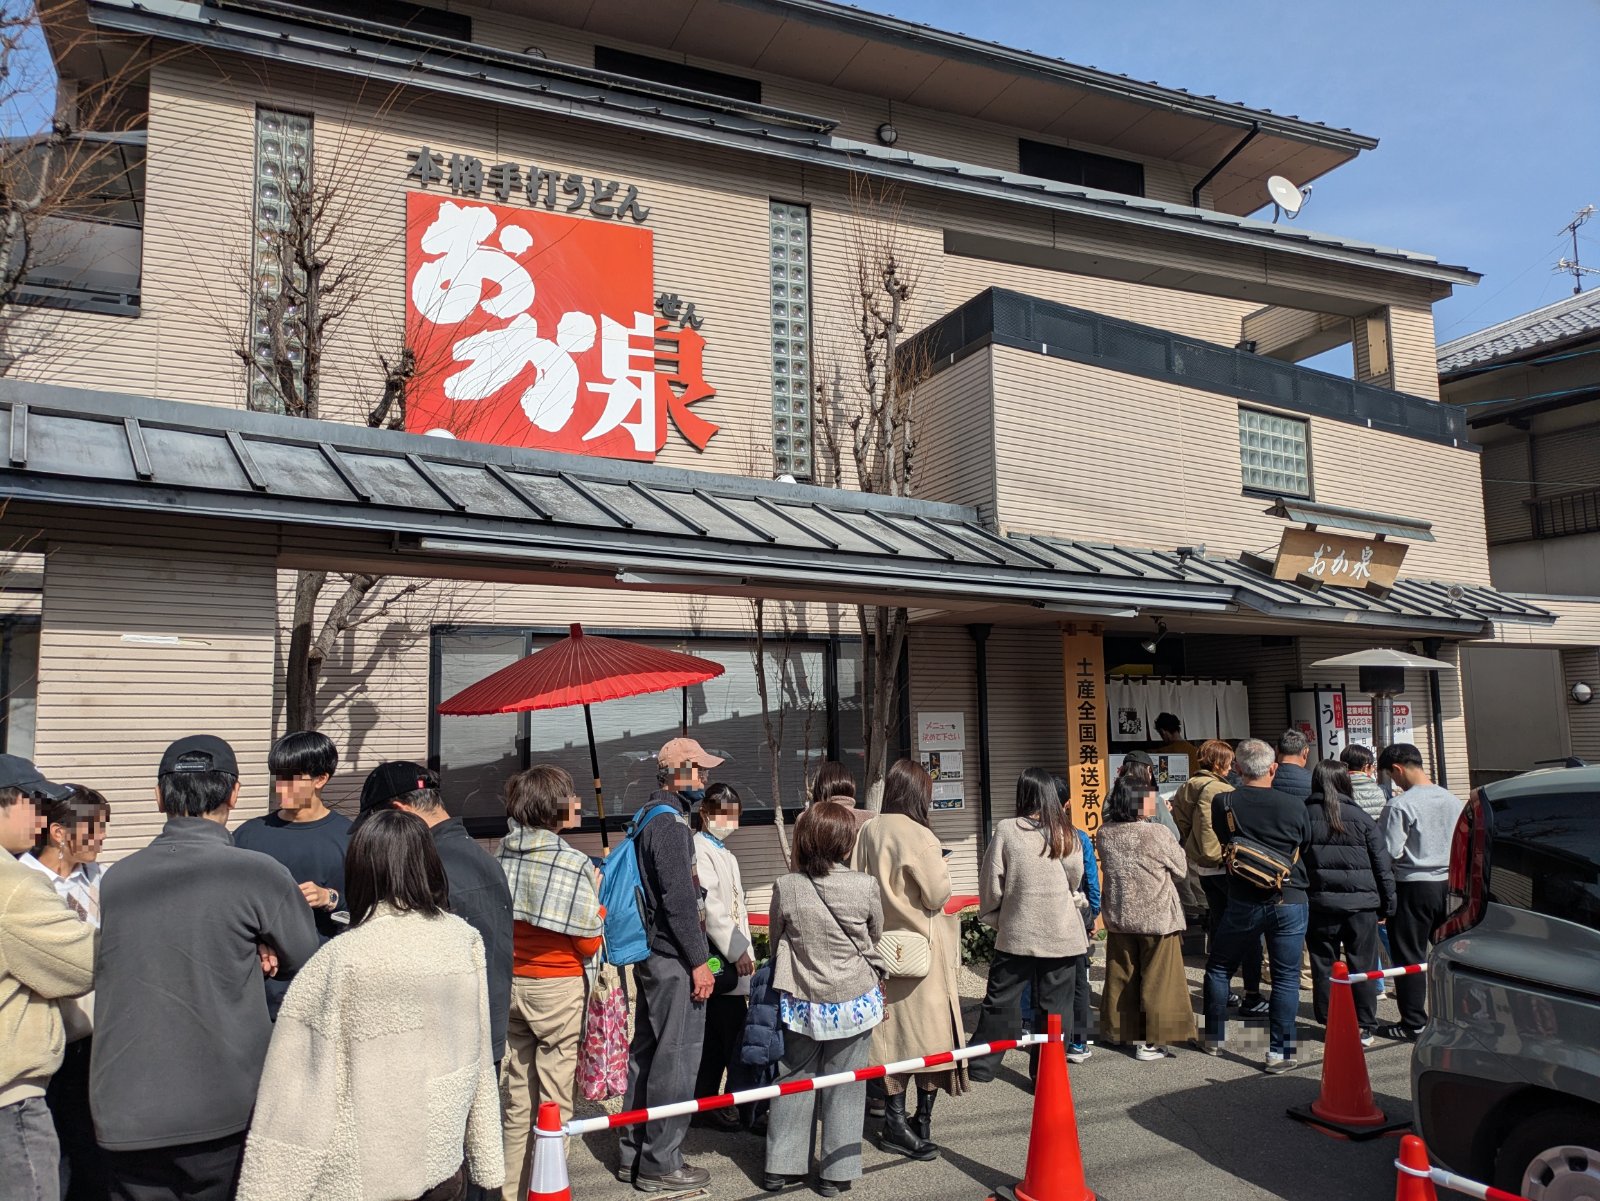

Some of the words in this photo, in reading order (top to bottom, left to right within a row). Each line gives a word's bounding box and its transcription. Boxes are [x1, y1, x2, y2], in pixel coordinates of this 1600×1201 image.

[407, 146, 650, 222] 本格手打うどん
[411, 200, 720, 454] おか泉
[656, 292, 704, 330] せん
[1307, 543, 1374, 580] おか泉
[1076, 657, 1101, 862] 土産全国発送承り
